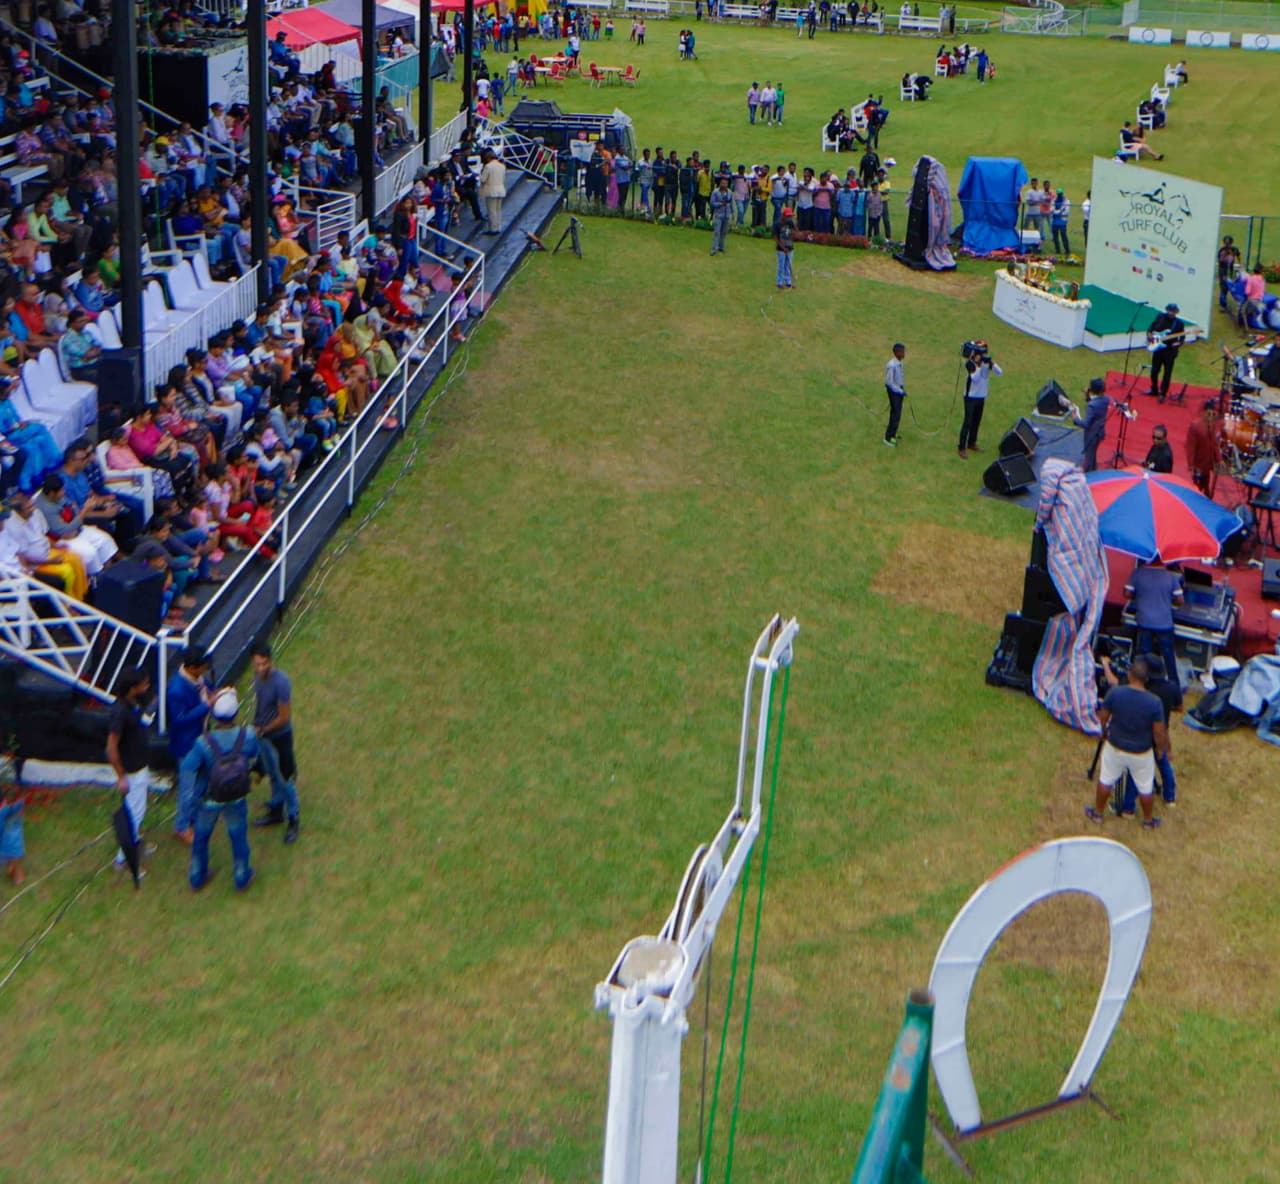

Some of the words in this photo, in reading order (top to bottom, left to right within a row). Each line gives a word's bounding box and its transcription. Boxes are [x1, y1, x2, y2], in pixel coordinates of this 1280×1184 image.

[1134, 203, 1177, 226] ROYAL
[1120, 219, 1152, 233] TURF
[1152, 222, 1188, 254] CLUB
